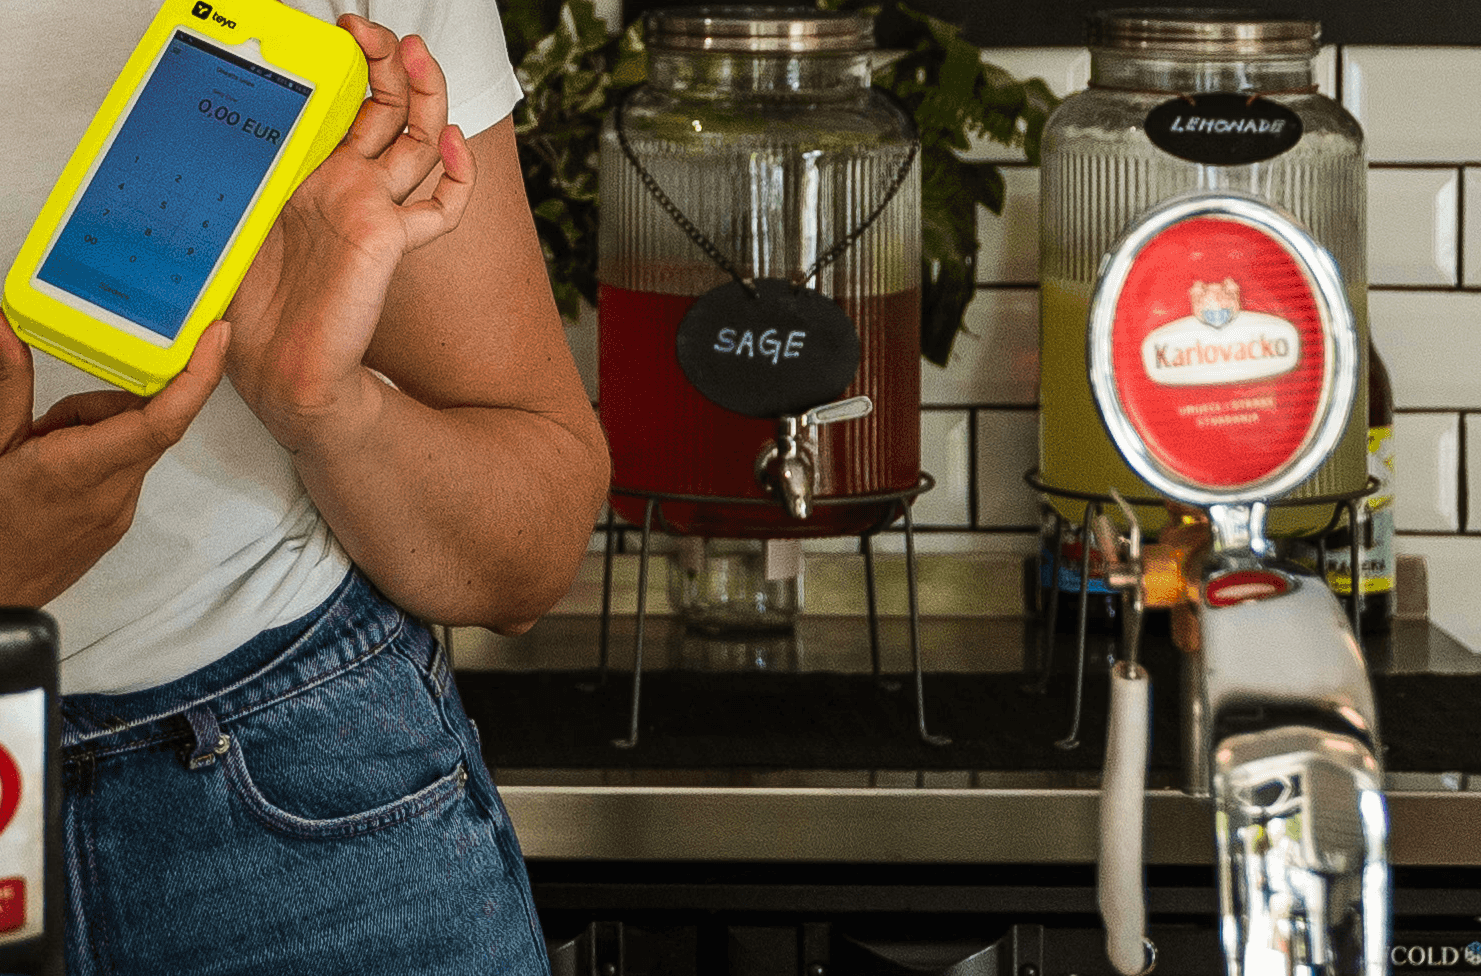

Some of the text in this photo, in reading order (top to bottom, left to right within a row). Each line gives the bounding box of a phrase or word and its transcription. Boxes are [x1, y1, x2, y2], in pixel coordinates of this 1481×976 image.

[211, 11, 237, 30] teya
[198, 98, 281, 145] 0,00 EUR
[1169, 115, 1286, 135] LEMONADE
[713, 327, 808, 365] SAGE
[1391, 946, 1461, 967] COLD
